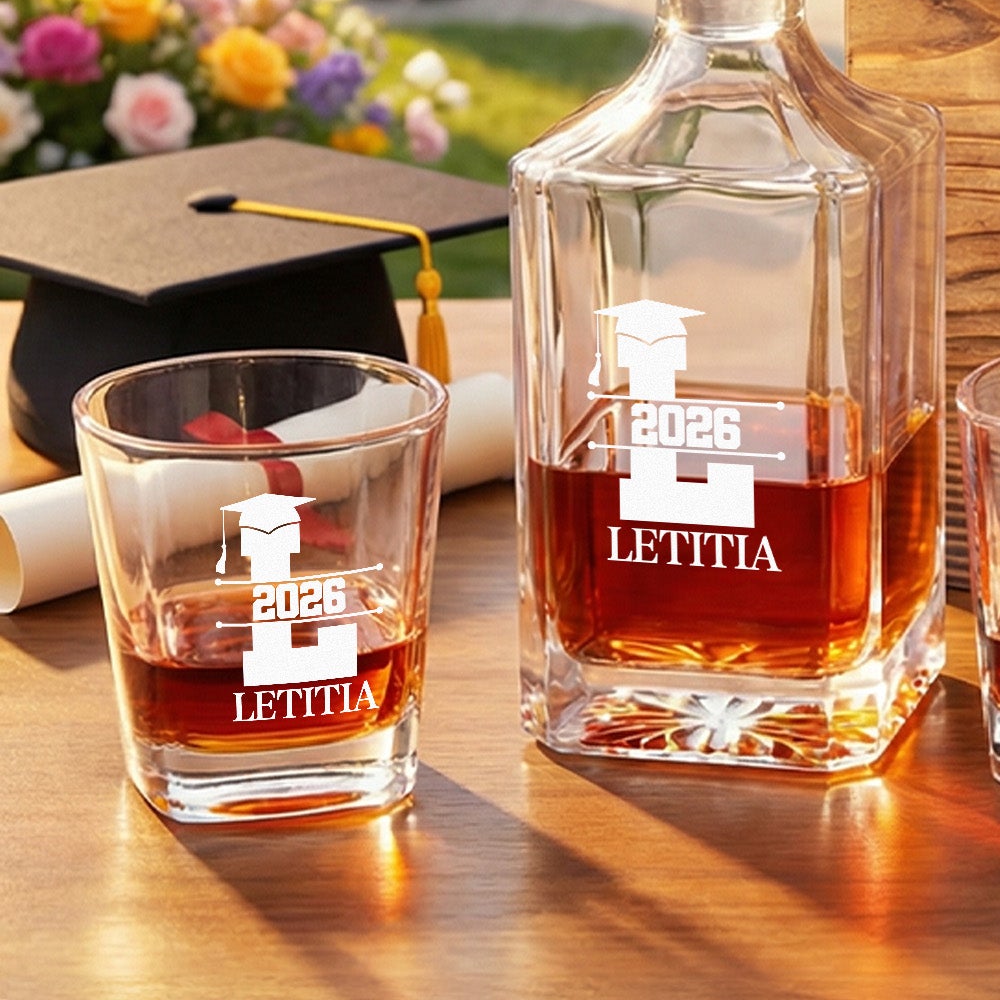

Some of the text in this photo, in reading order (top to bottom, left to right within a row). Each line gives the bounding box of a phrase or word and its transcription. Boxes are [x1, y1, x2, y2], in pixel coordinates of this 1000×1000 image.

[631, 403, 741, 450] 2026
[607, 526, 782, 572] LETITIA
[252, 577, 346, 621] 2026
[233, 680, 379, 722] LETITIA
